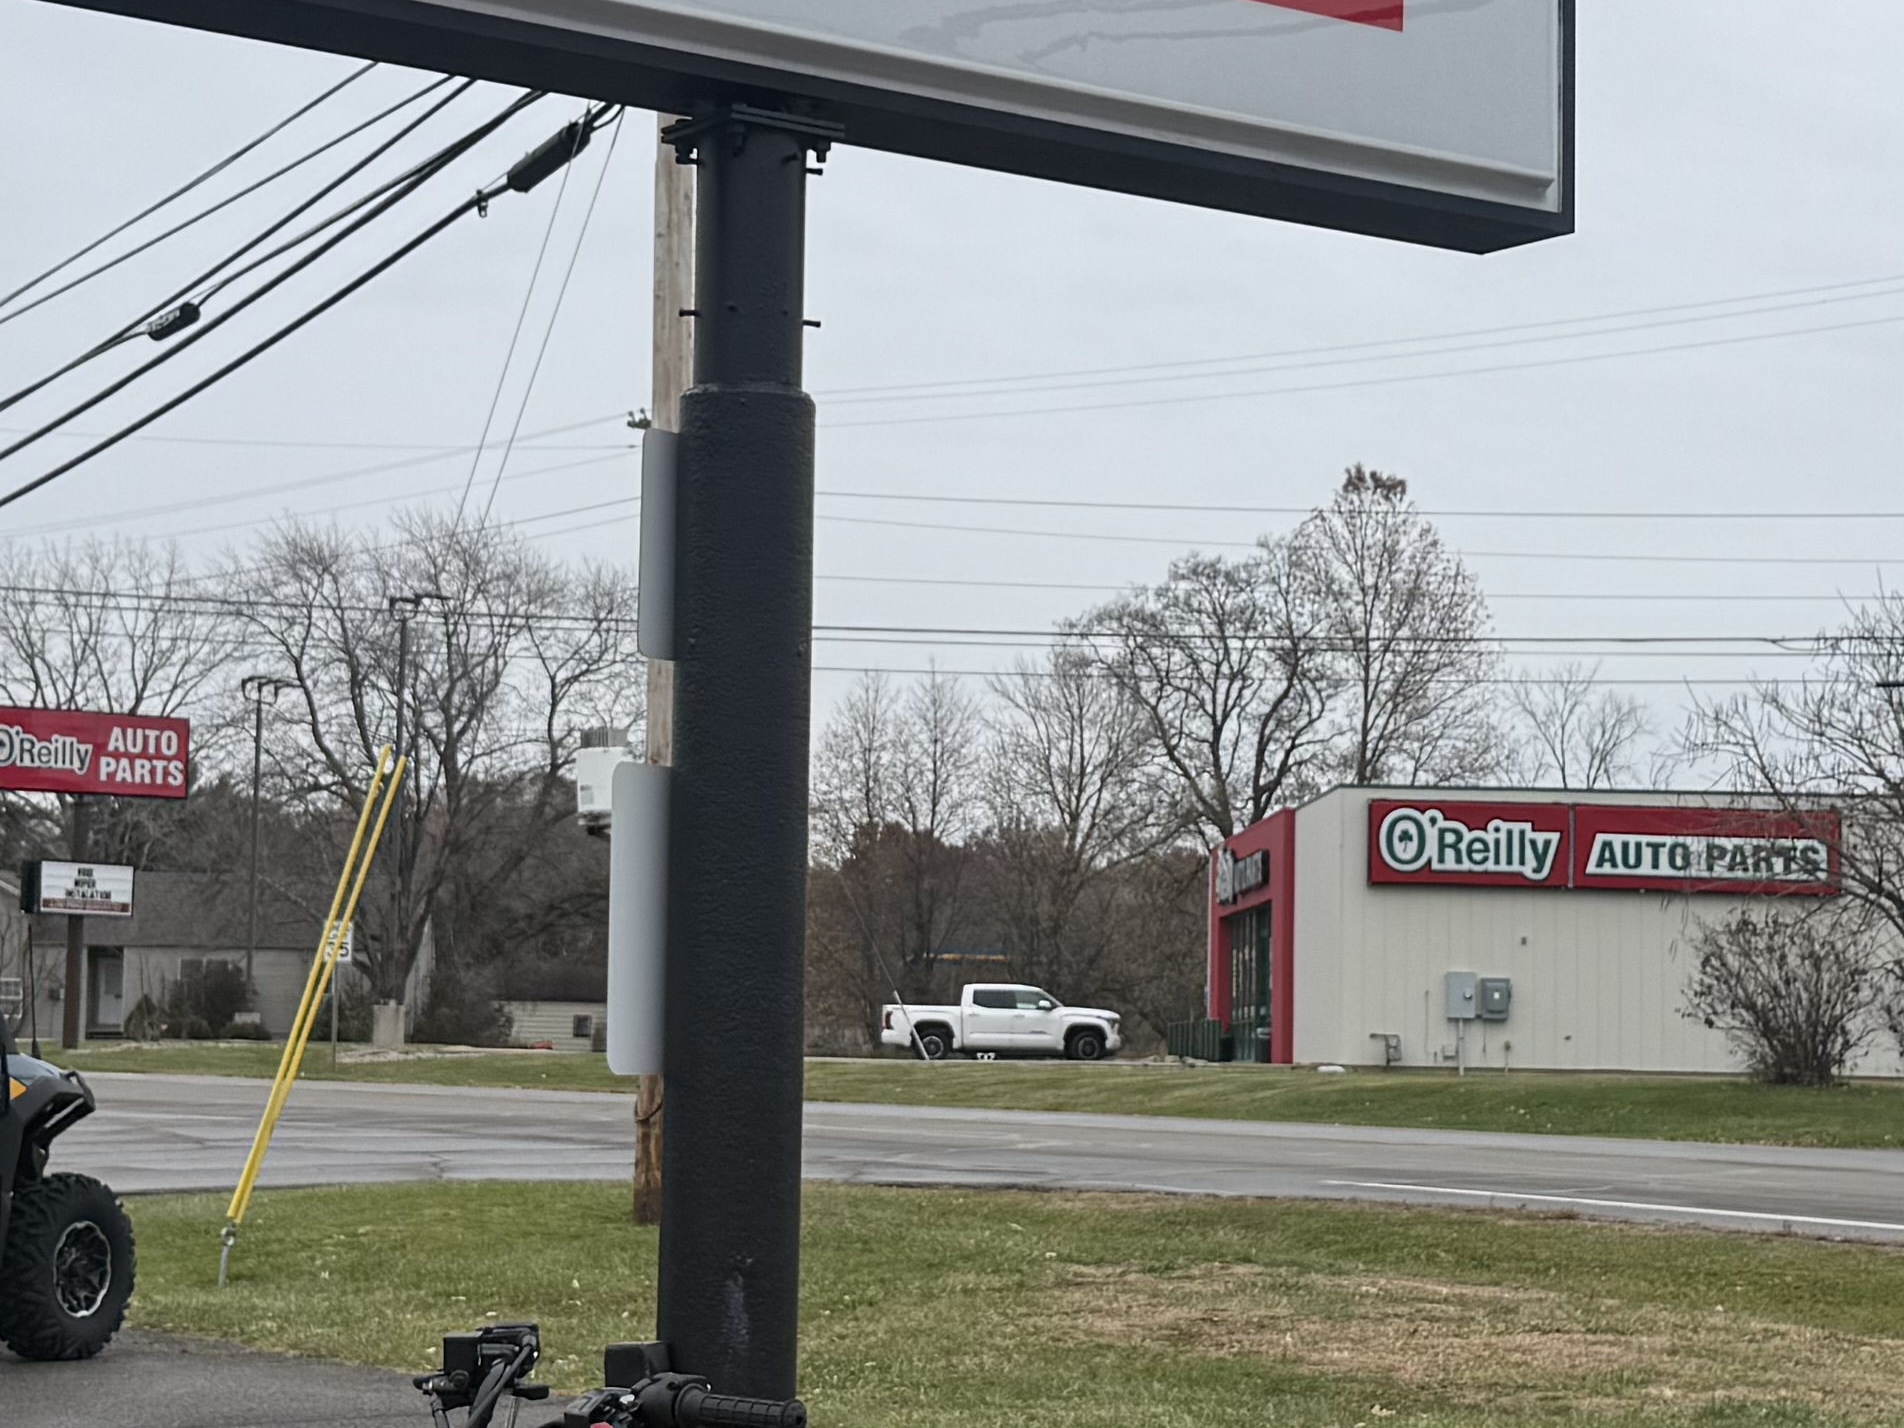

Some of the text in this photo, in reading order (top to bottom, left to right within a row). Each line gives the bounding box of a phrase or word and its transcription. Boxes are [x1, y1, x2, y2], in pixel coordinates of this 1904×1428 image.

[107, 726, 178, 756] AUTO
[99, 756, 184, 786] PARTS
[1382, 811, 1821, 877] O'Reilly AUTO PARTS
